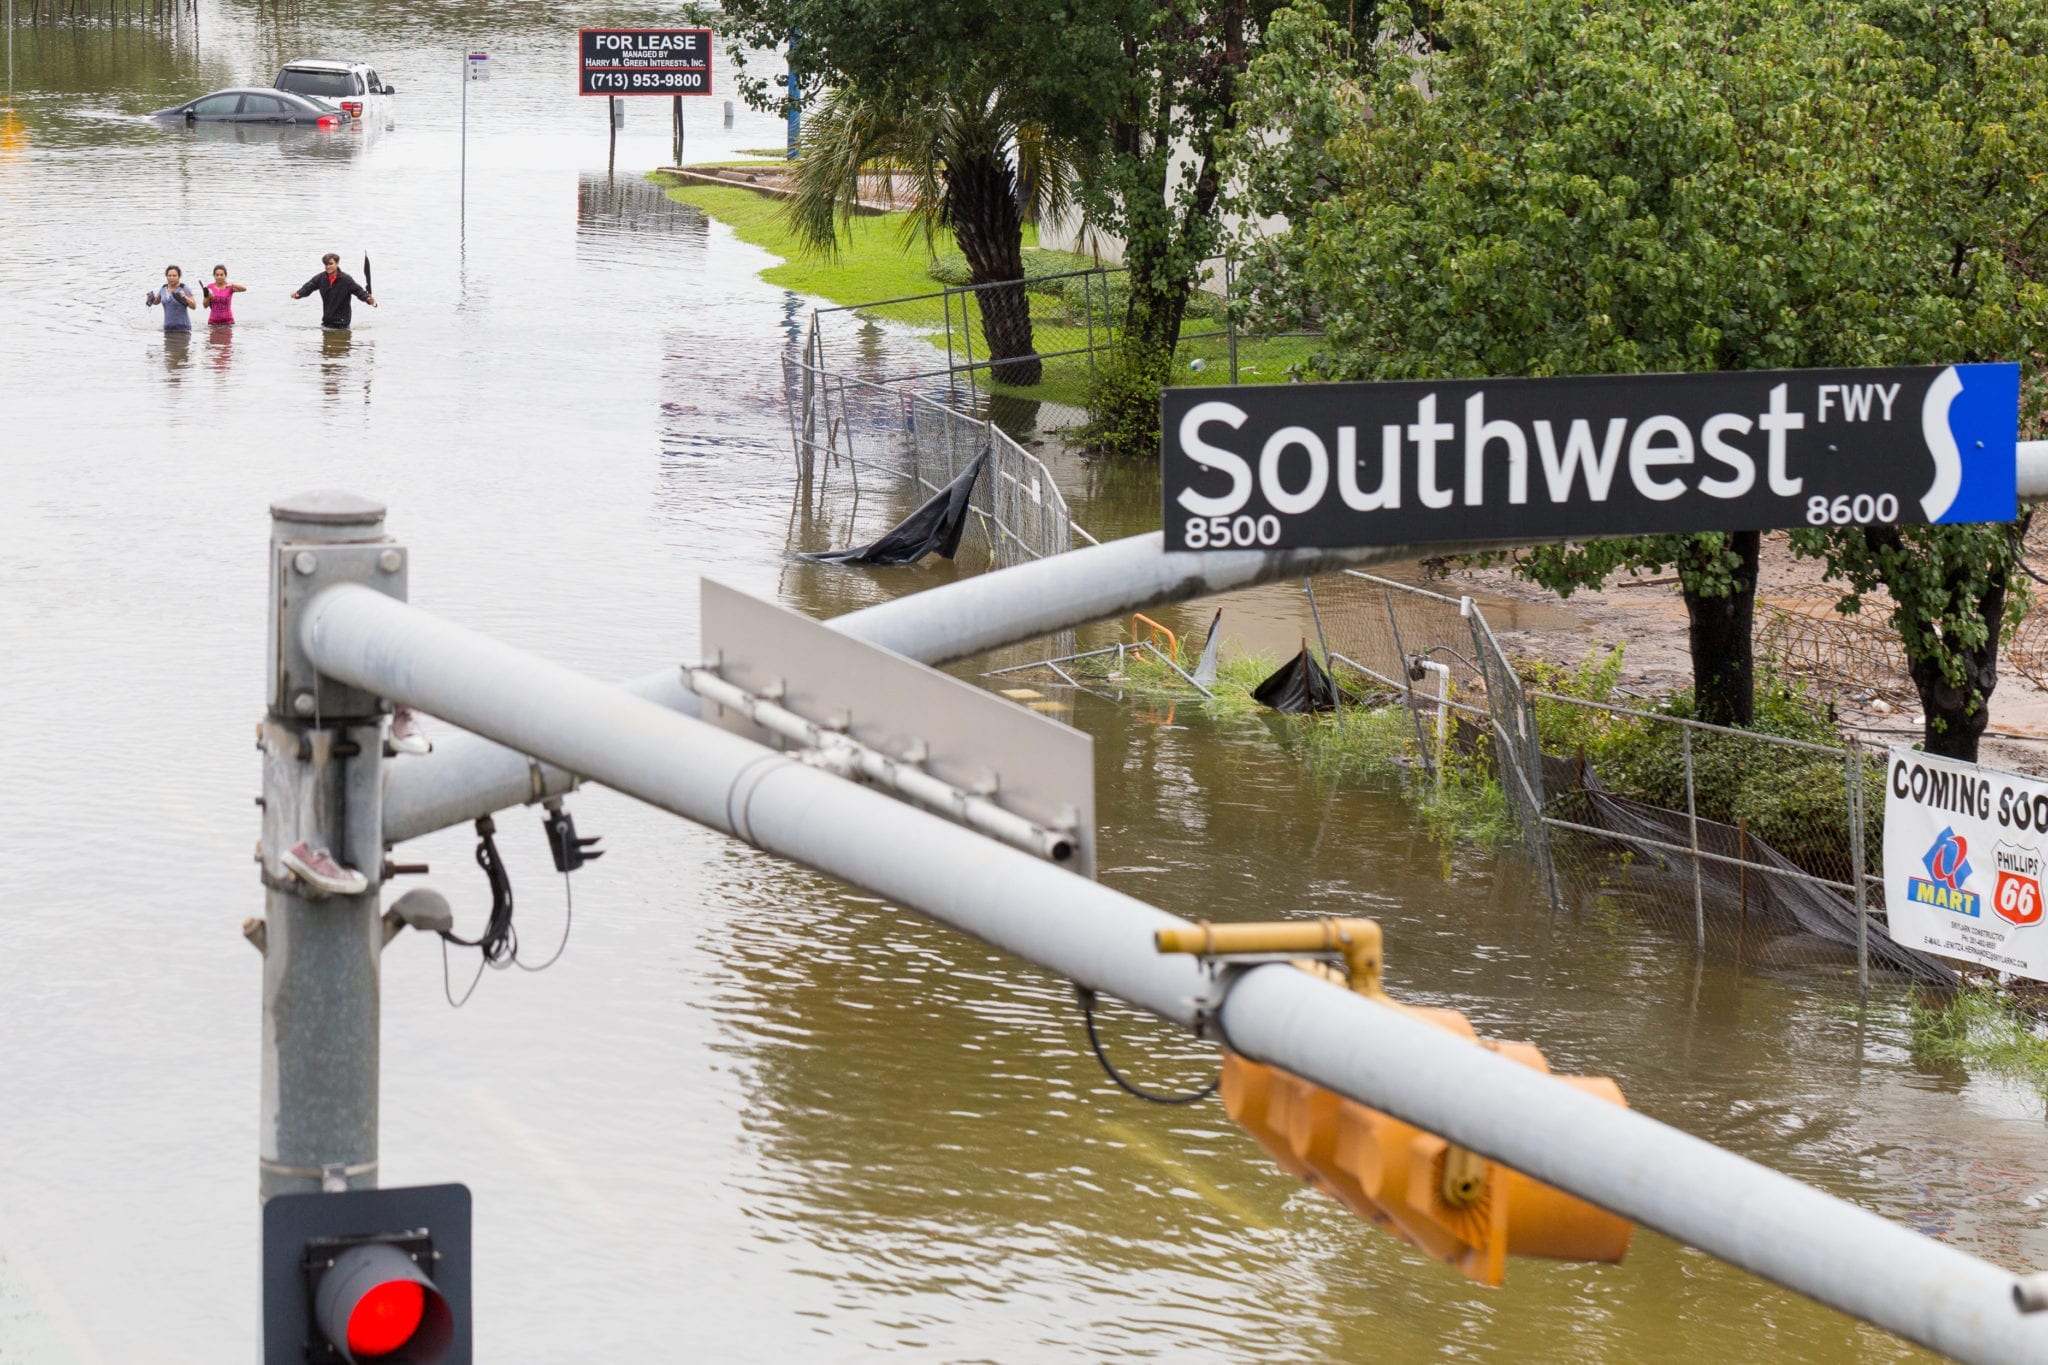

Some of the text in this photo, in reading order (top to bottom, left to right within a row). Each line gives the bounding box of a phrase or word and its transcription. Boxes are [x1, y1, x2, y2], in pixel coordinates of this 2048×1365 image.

[596, 35, 696, 50] FOR LEASE
[585, 58, 706, 68] HARRY M. GREEN INTERESTS, INC.
[590, 73, 701, 89] (713) 953-9800
[1177, 383, 1901, 517] Southwest FWY
[1806, 493, 1899, 525] 8600
[1185, 514, 1281, 548] 8500
[1893, 759, 2048, 834] COMING SOO
[1997, 851, 2038, 876] PHILLIPS
[1917, 882, 1974, 914] MART
[2001, 877, 2035, 916] 66
